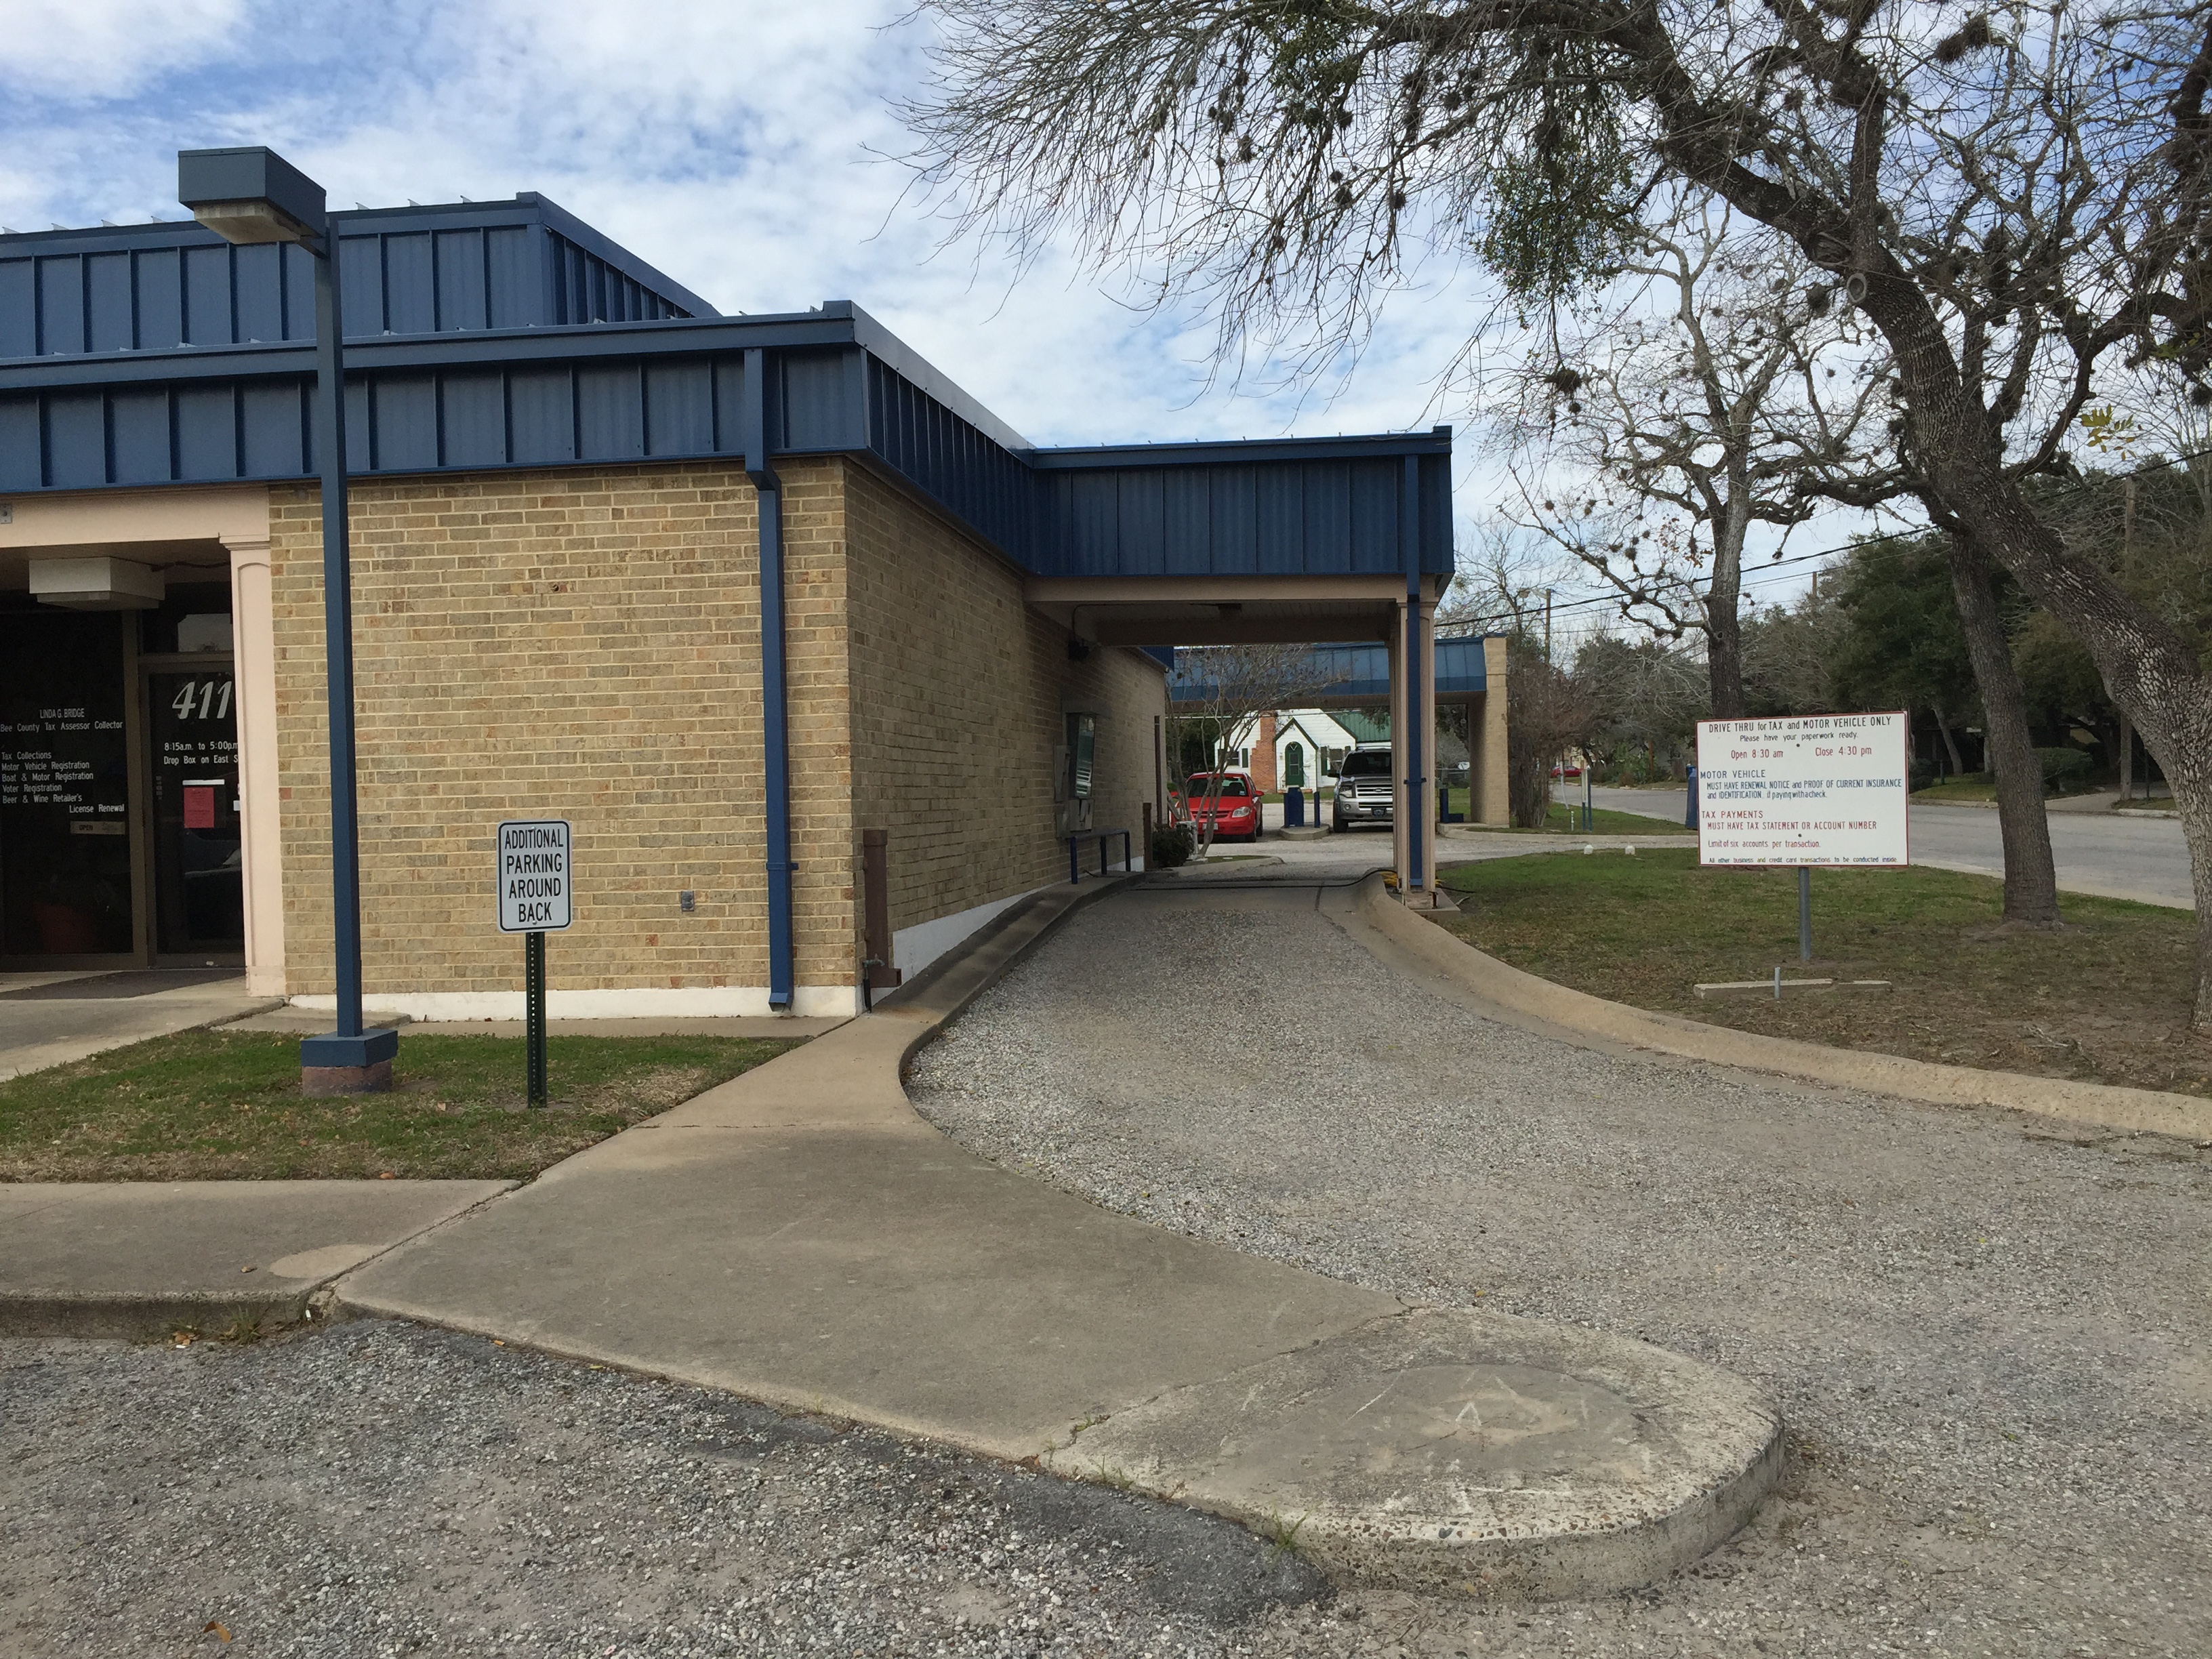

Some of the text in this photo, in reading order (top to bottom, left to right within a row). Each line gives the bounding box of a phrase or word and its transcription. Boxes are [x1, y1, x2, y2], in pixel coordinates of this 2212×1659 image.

[172, 681, 232, 719] 411
[40, 710, 56, 718] LINDA
[64, 708, 85, 718] BRIDGE
[0, 724, 12, 732] Bee
[18, 723, 40, 733] County
[45, 722, 56, 731] Tax
[95, 721, 123, 729] Collector
[1709, 716, 1891, 733] DRIVE THRU for TAX and MOTOR VEHICLE ONLY
[1801, 732, 1834, 741] paperwork
[1839, 731, 1858, 739] ready.
[17, 752, 52, 760] Collections
[1731, 750, 1747, 760] Open
[1752, 749, 1769, 758] 8:30
[1816, 746, 1872, 756] Close 4:30 pm
[164, 756, 179, 766] Drop
[184, 756, 196, 764] Box
[213, 755, 228, 763] East
[52, 761, 89, 772] Registration
[21, 773, 27, 781] &
[56, 773, 94, 783] Registration
[1732, 770, 1765, 778] VEHICLE
[24, 784, 62, 794] Registration
[1769, 781, 1790, 789] NOTICE
[1804, 780, 1823, 788] PROOF
[1837, 779, 1864, 787] CURRENT
[3, 796, 18, 804] Beer
[22, 795, 28, 803] &
[54, 794, 82, 802] Retailer's
[1772, 792, 1791, 800] paying
[98, 804, 124, 812] Renewal
[1702, 811, 1715, 819] TAX
[1814, 821, 1845, 830] ACCOUNT
[1849, 821, 1877, 830] NUMBER
[505, 829, 564, 849] ADDITIONAL
[507, 853, 562, 874] PARKING
[509, 878, 561, 899] AROUND
[518, 902, 552, 922] BACK
